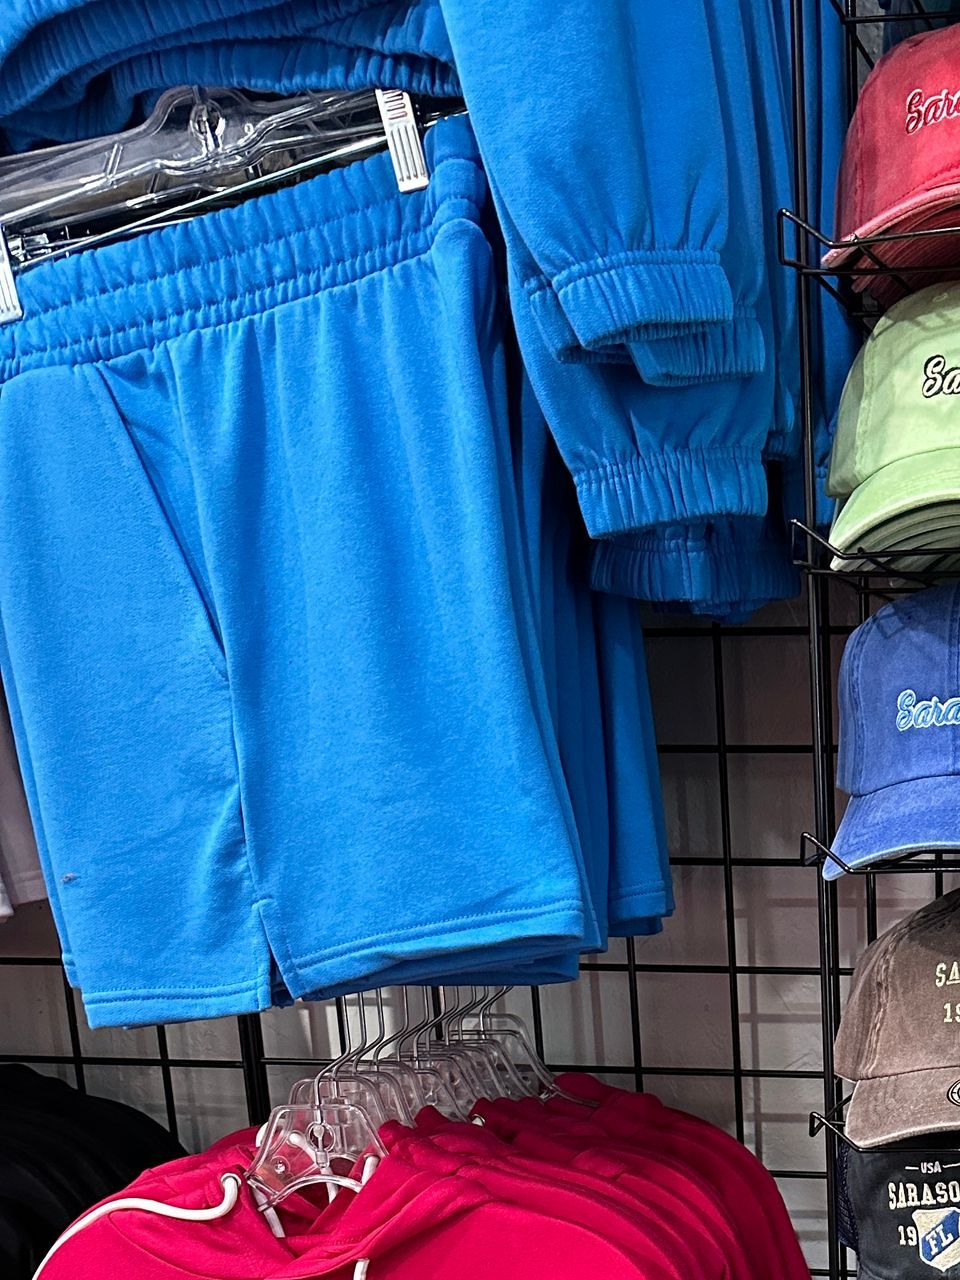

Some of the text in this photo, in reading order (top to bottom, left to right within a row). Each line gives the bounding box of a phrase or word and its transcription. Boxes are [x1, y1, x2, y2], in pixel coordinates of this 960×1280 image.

[920, 1161, 942, 1174] USA
[897, 1225, 918, 1246] 19
[925, 1224, 954, 1256] FL
